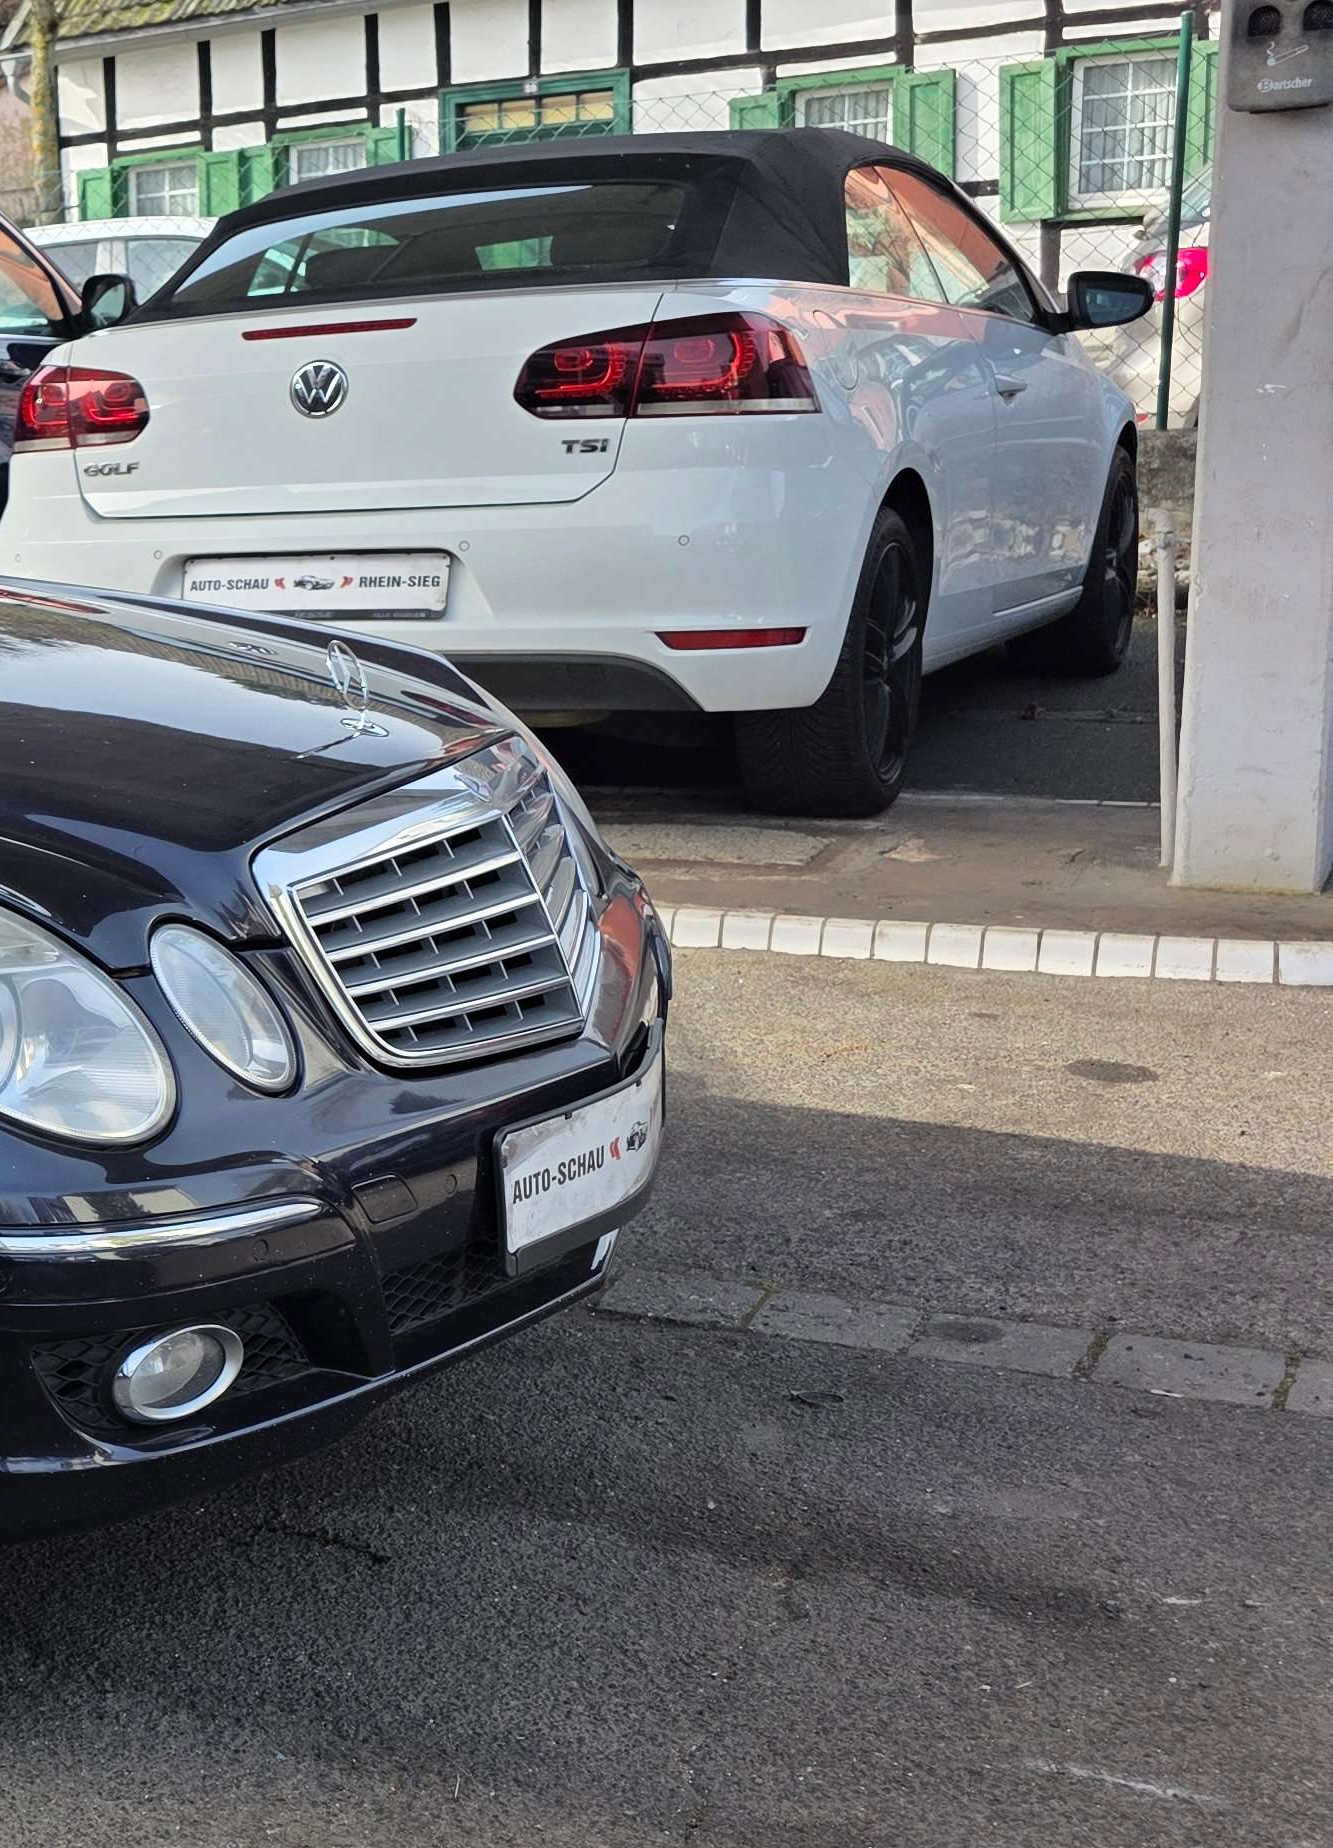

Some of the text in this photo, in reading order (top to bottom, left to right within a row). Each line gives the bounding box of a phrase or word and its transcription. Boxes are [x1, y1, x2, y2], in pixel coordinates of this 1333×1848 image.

[1256, 76, 1313, 93] Bartscher
[561, 438, 609, 453] TSI
[82, 461, 141, 477] GOLF
[190, 575, 441, 591] AUTO-SCHAU RHEIN-SIEG
[512, 1145, 605, 1205] AUTO-SCHAU
